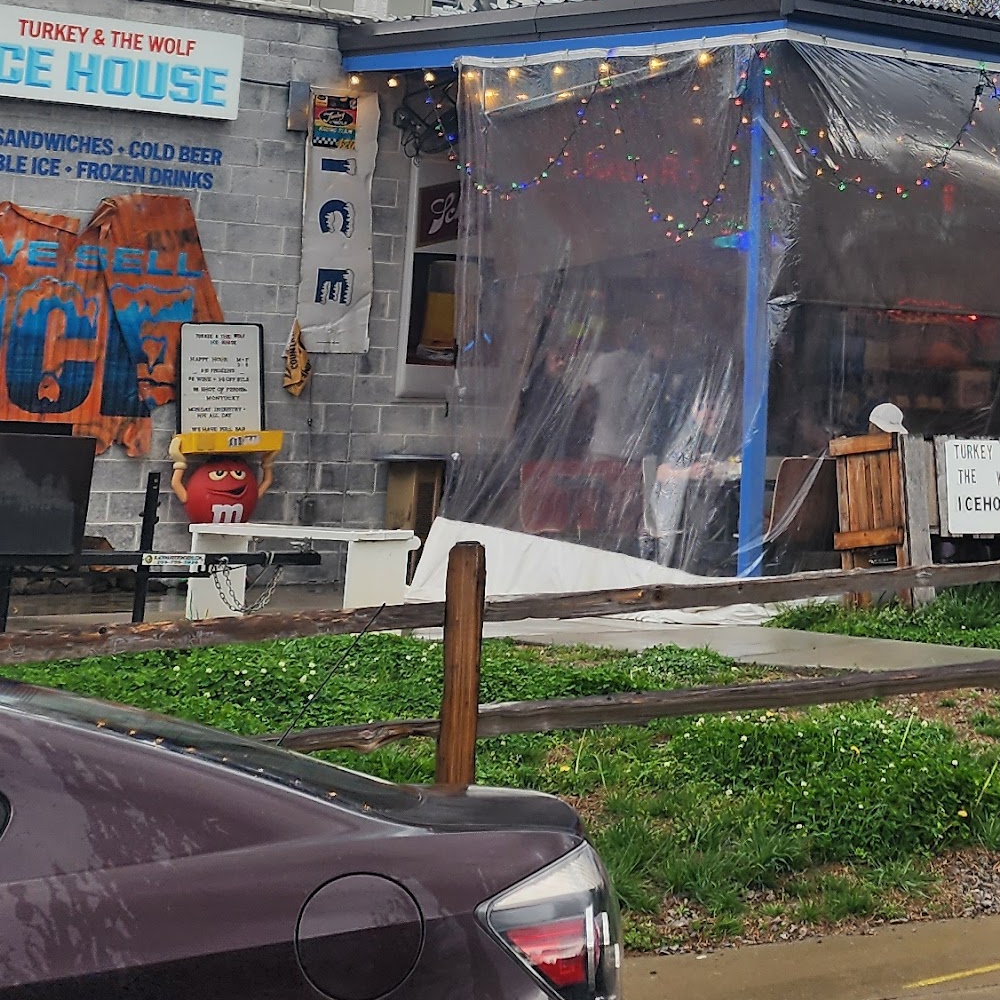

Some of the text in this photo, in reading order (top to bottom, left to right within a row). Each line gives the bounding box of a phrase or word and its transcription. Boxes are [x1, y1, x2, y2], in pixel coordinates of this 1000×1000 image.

[18, 19, 197, 57] TURKEY & THE WOLF
[66, 51, 229, 108] HOUSE
[128, 140, 175, 161] COLD
[178, 145, 223, 166] BEER
[31, 156, 61, 177] ICE
[76, 160, 146, 184] FROZEN
[149, 169, 214, 190] DRINKS
[75, 245, 203, 279] SELL
[0, 272, 195, 417] CE
[953, 443, 993, 460] TURKEY
[957, 468, 977, 485] THE
